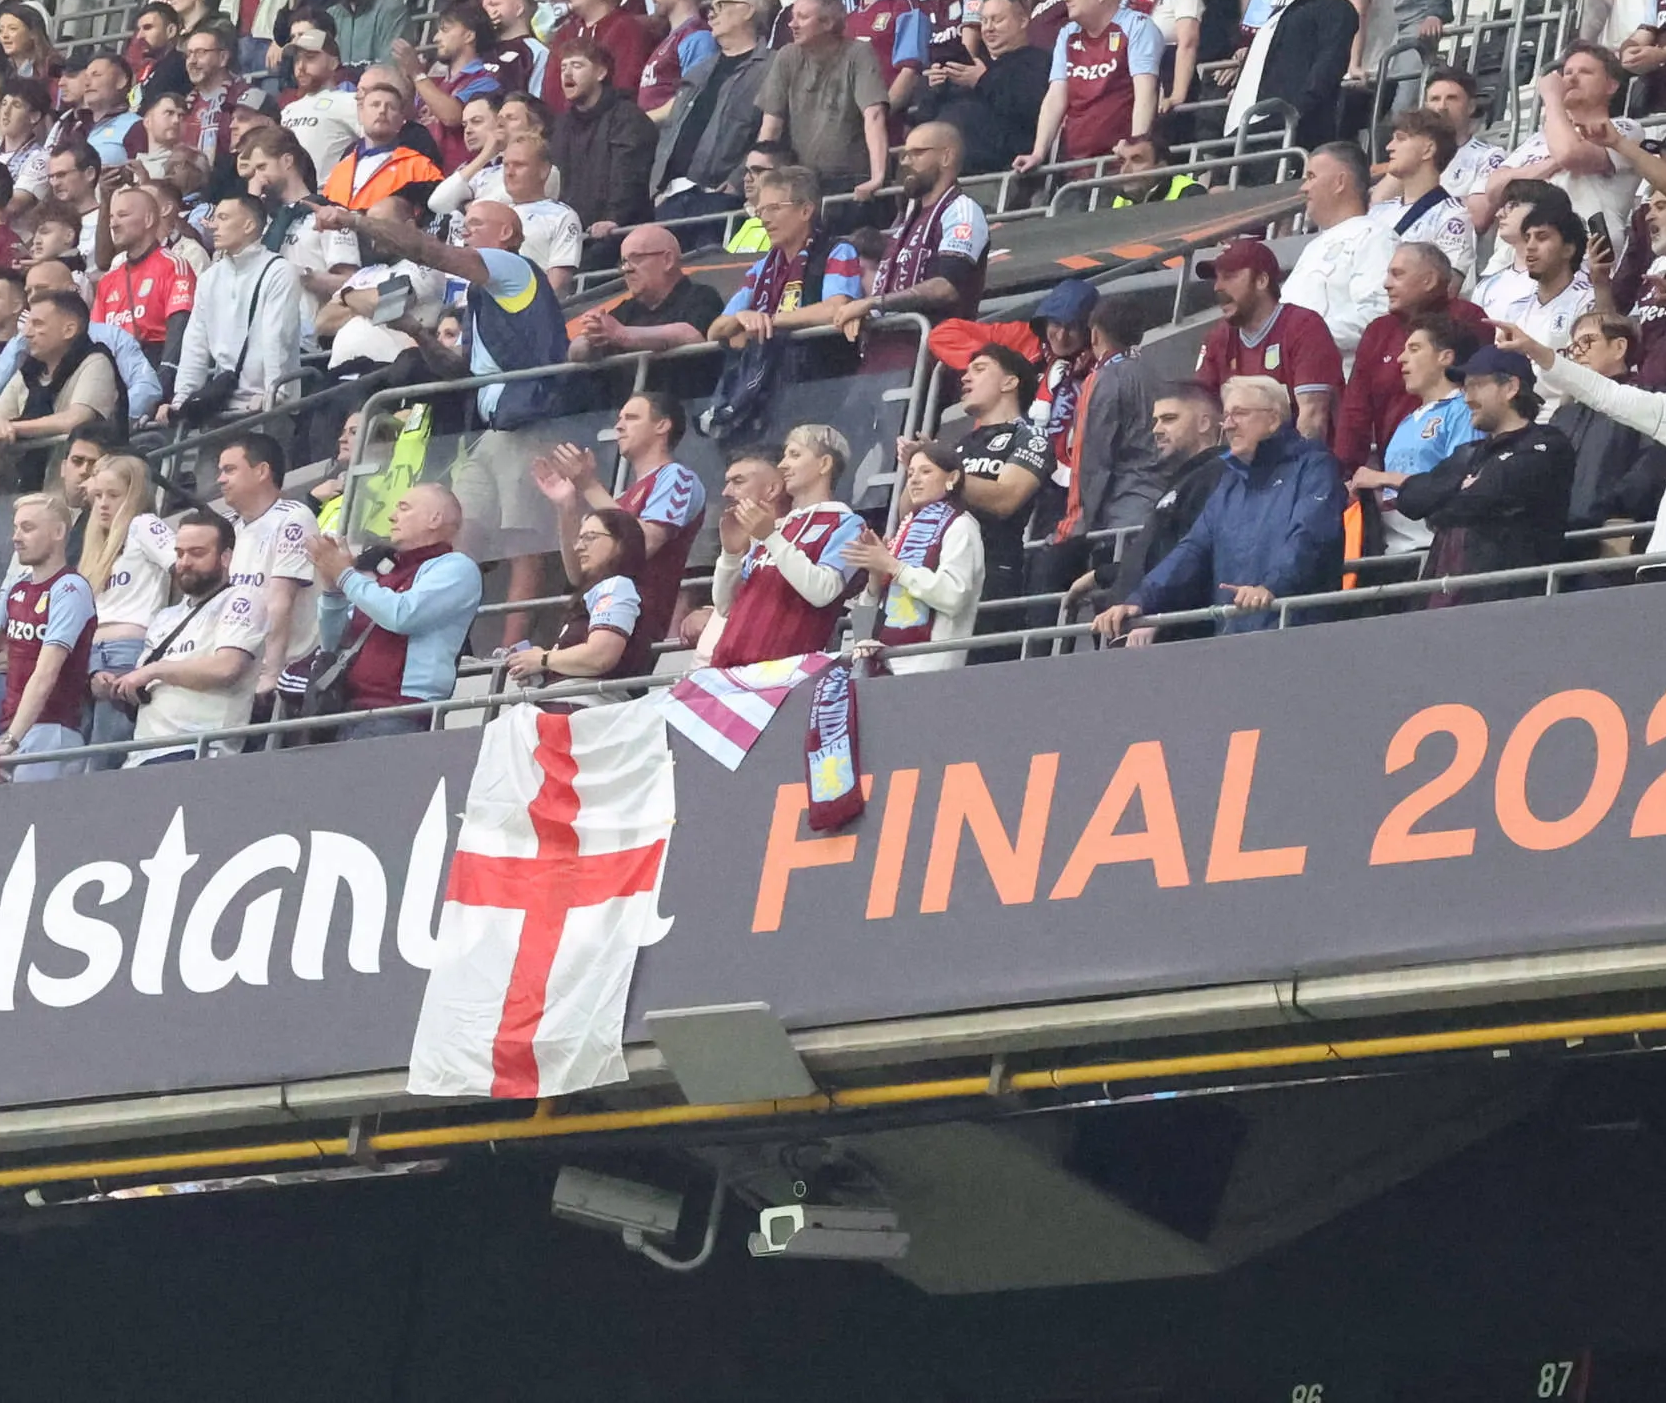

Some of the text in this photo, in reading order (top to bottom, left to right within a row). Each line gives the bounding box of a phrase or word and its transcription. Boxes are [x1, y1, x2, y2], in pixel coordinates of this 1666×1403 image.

[105, 305, 145, 326] Betao
[962, 458, 1005, 478] tano
[229, 573, 264, 587] tano
[7, 619, 49, 641] AZOO
[751, 729, 1307, 933] FINAL
[1538, 1361, 1573, 1398] 87
